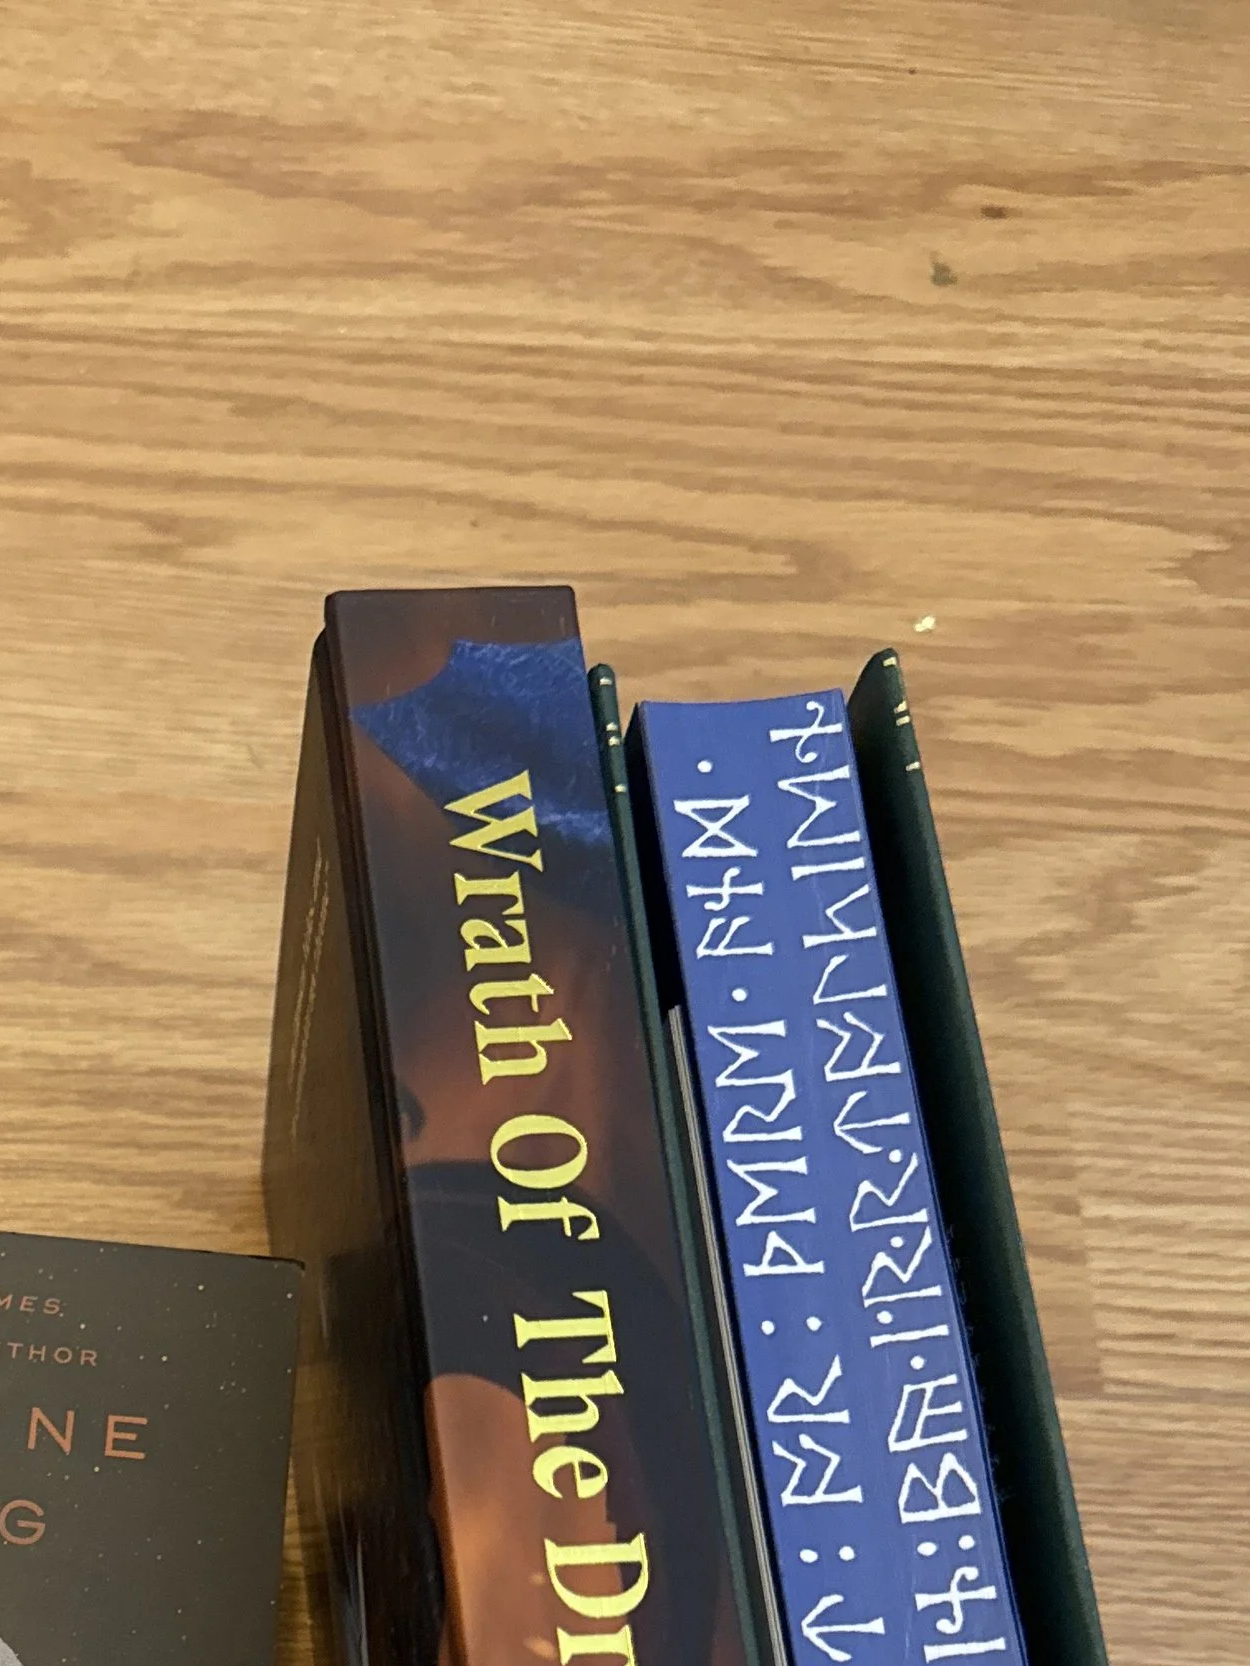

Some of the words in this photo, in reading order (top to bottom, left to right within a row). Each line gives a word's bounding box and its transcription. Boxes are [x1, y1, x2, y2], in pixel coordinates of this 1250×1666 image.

[444, 770, 573, 1086] Wrath
[490, 1113, 600, 1240] Of
[513, 1288, 625, 1499] The
